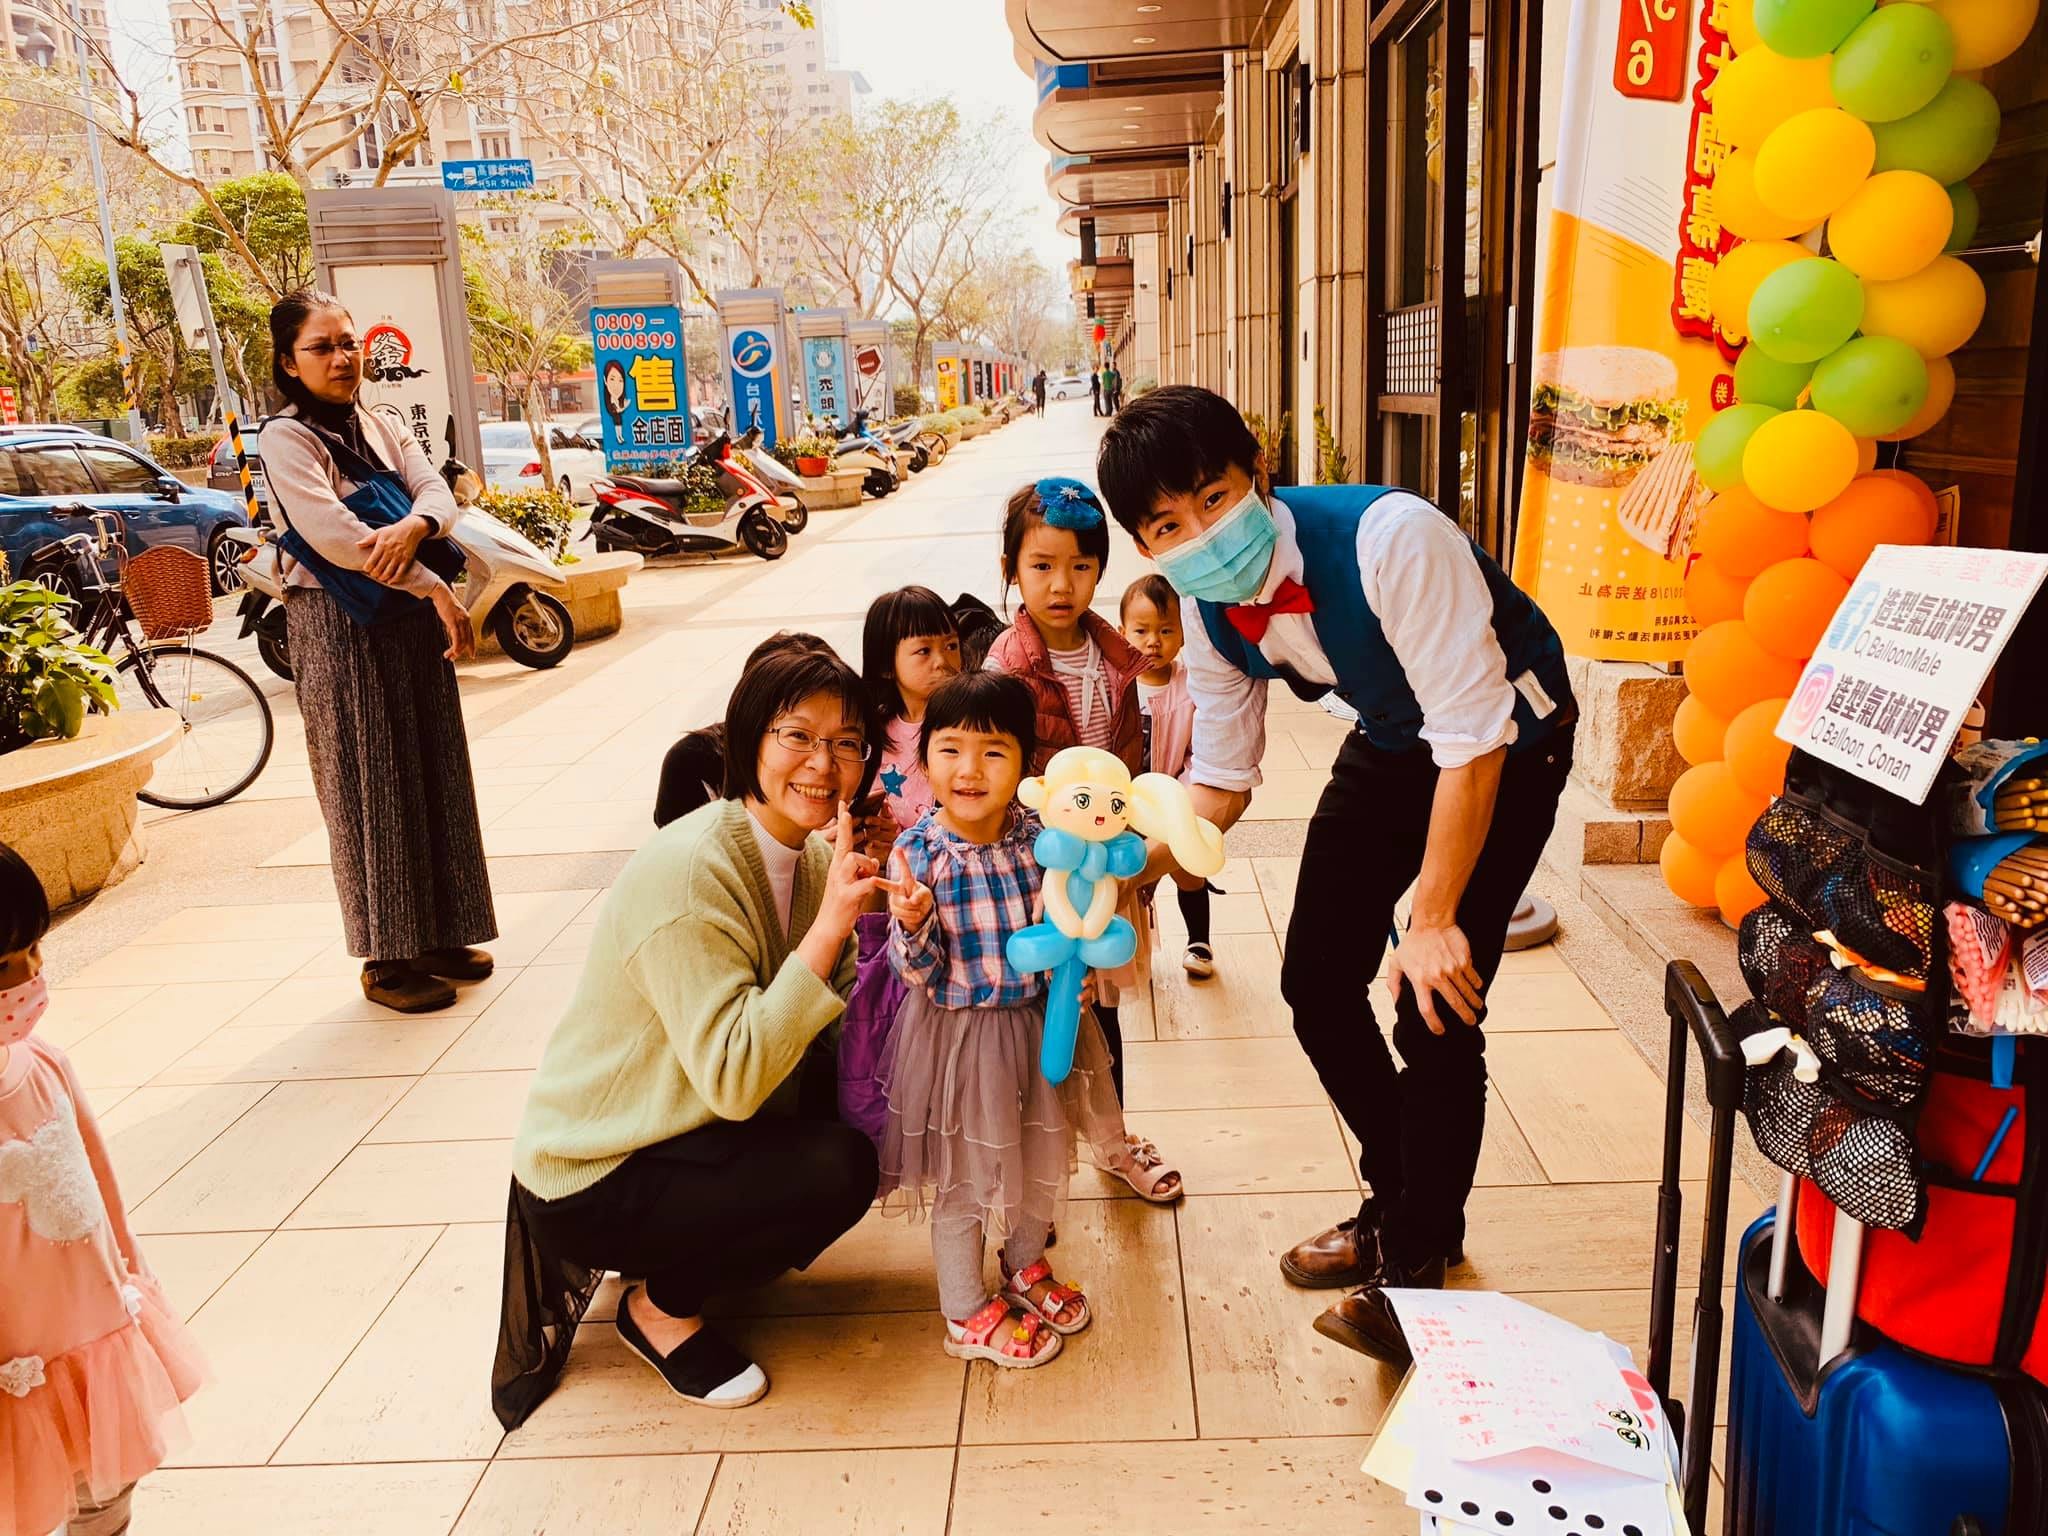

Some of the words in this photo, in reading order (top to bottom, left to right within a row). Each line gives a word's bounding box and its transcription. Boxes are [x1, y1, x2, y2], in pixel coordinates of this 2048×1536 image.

[501, 177, 533, 188] Statio
[597, 331, 676, 351] 000899
[628, 354, 677, 412] 售
[631, 415, 685, 445] 金店面
[1870, 587, 2008, 653] 造型氣球柯男
[1867, 632, 1942, 676] BalloonMale
[1825, 673, 1951, 754] 造型氣球柯男
[1822, 722, 1912, 782] Balloon_Conan
